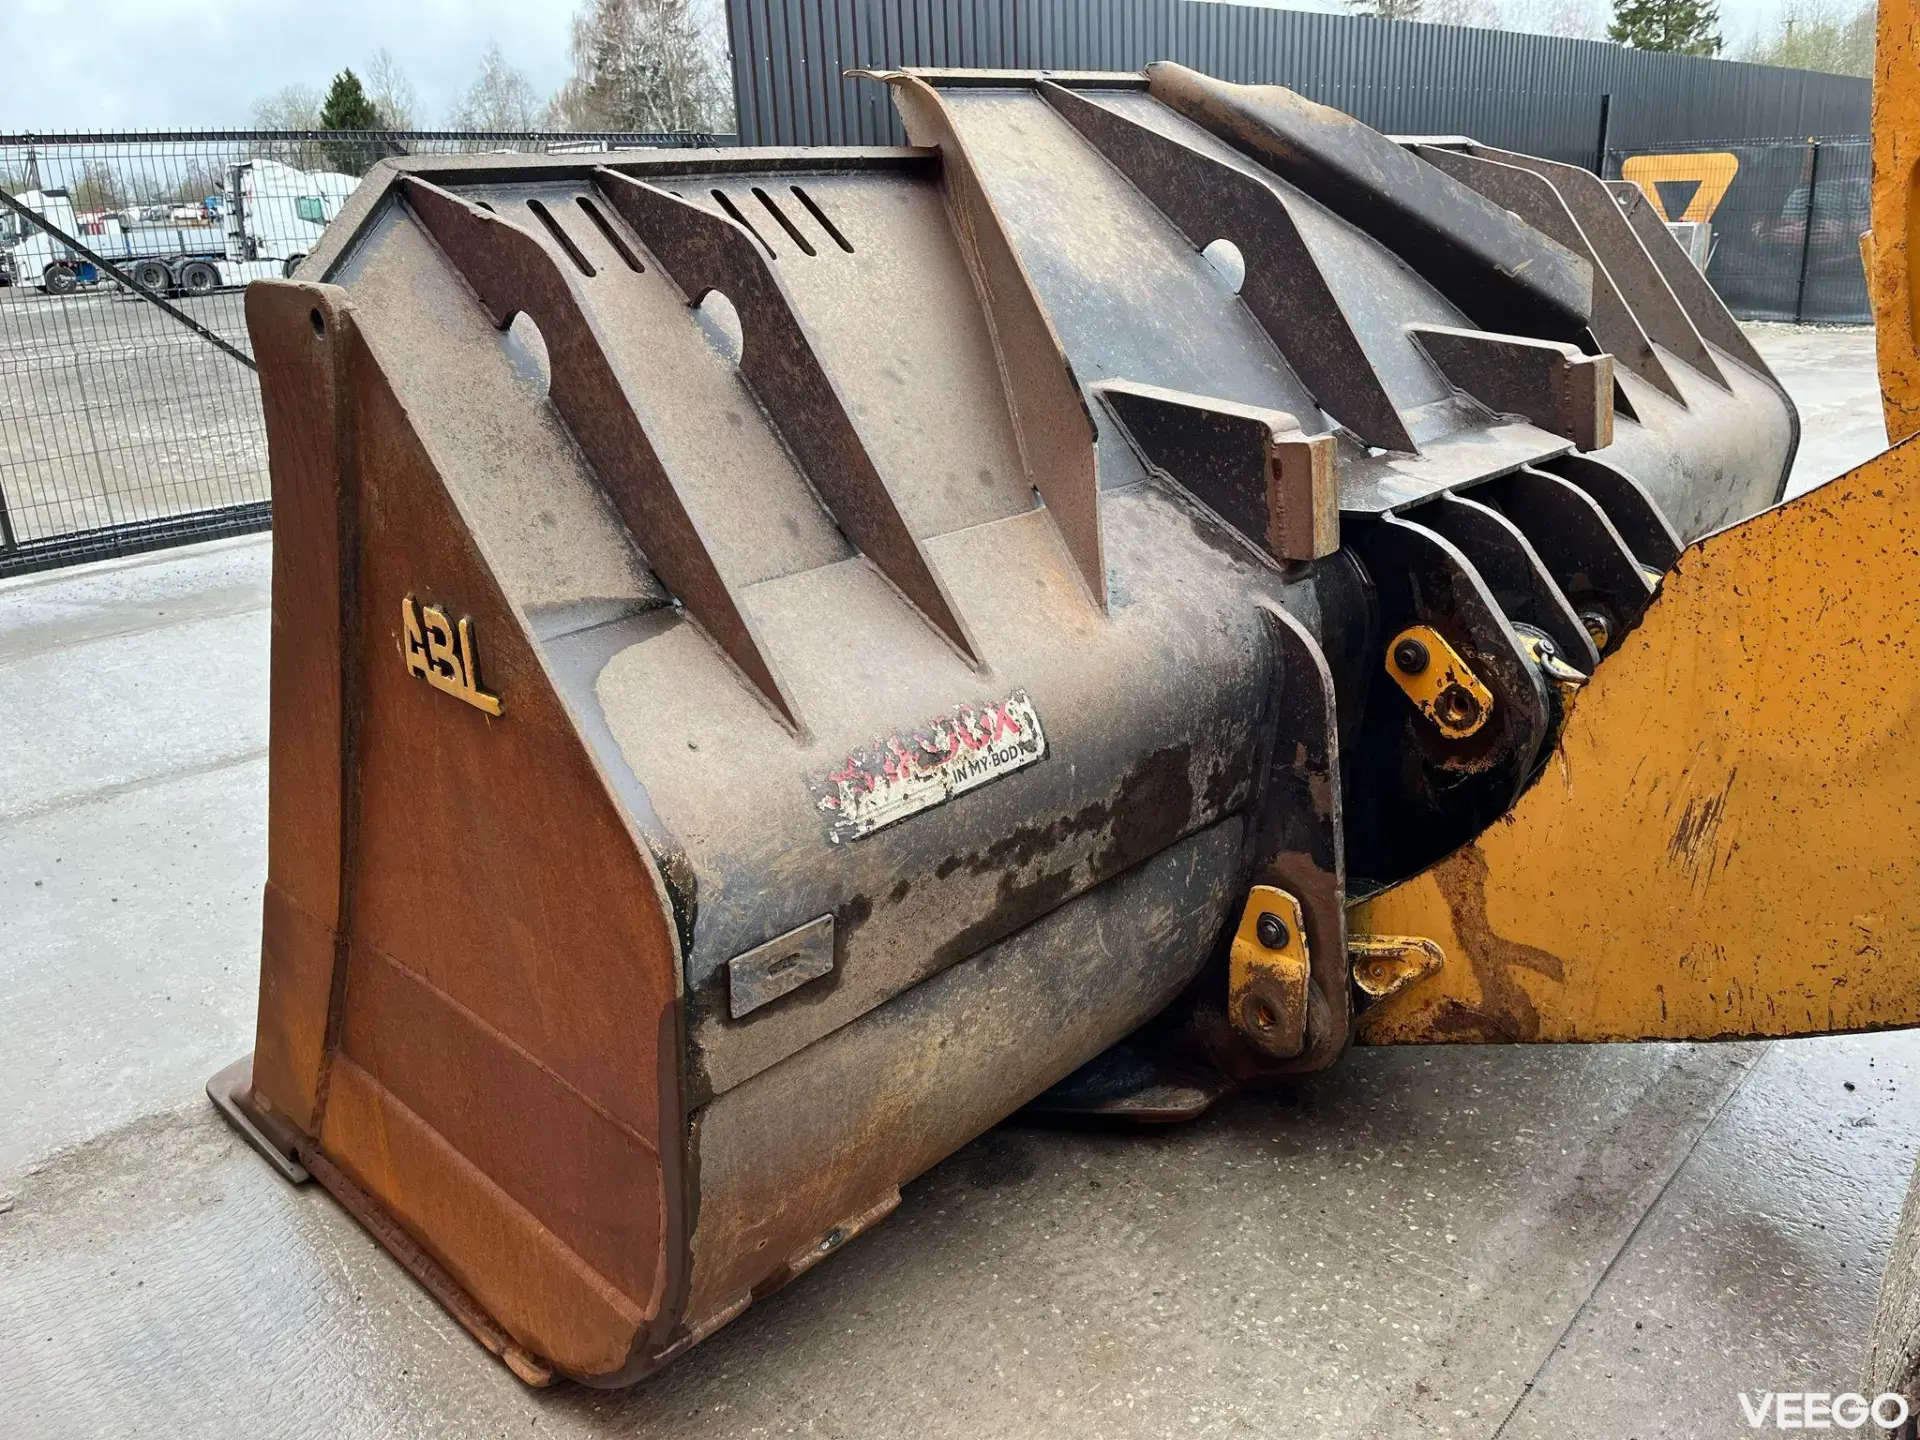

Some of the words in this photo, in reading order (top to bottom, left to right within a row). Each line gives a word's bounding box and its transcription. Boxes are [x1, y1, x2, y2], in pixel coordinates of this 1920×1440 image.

[402, 598, 503, 716] ABL
[952, 765, 968, 784] IN
[968, 756, 988, 777] MY
